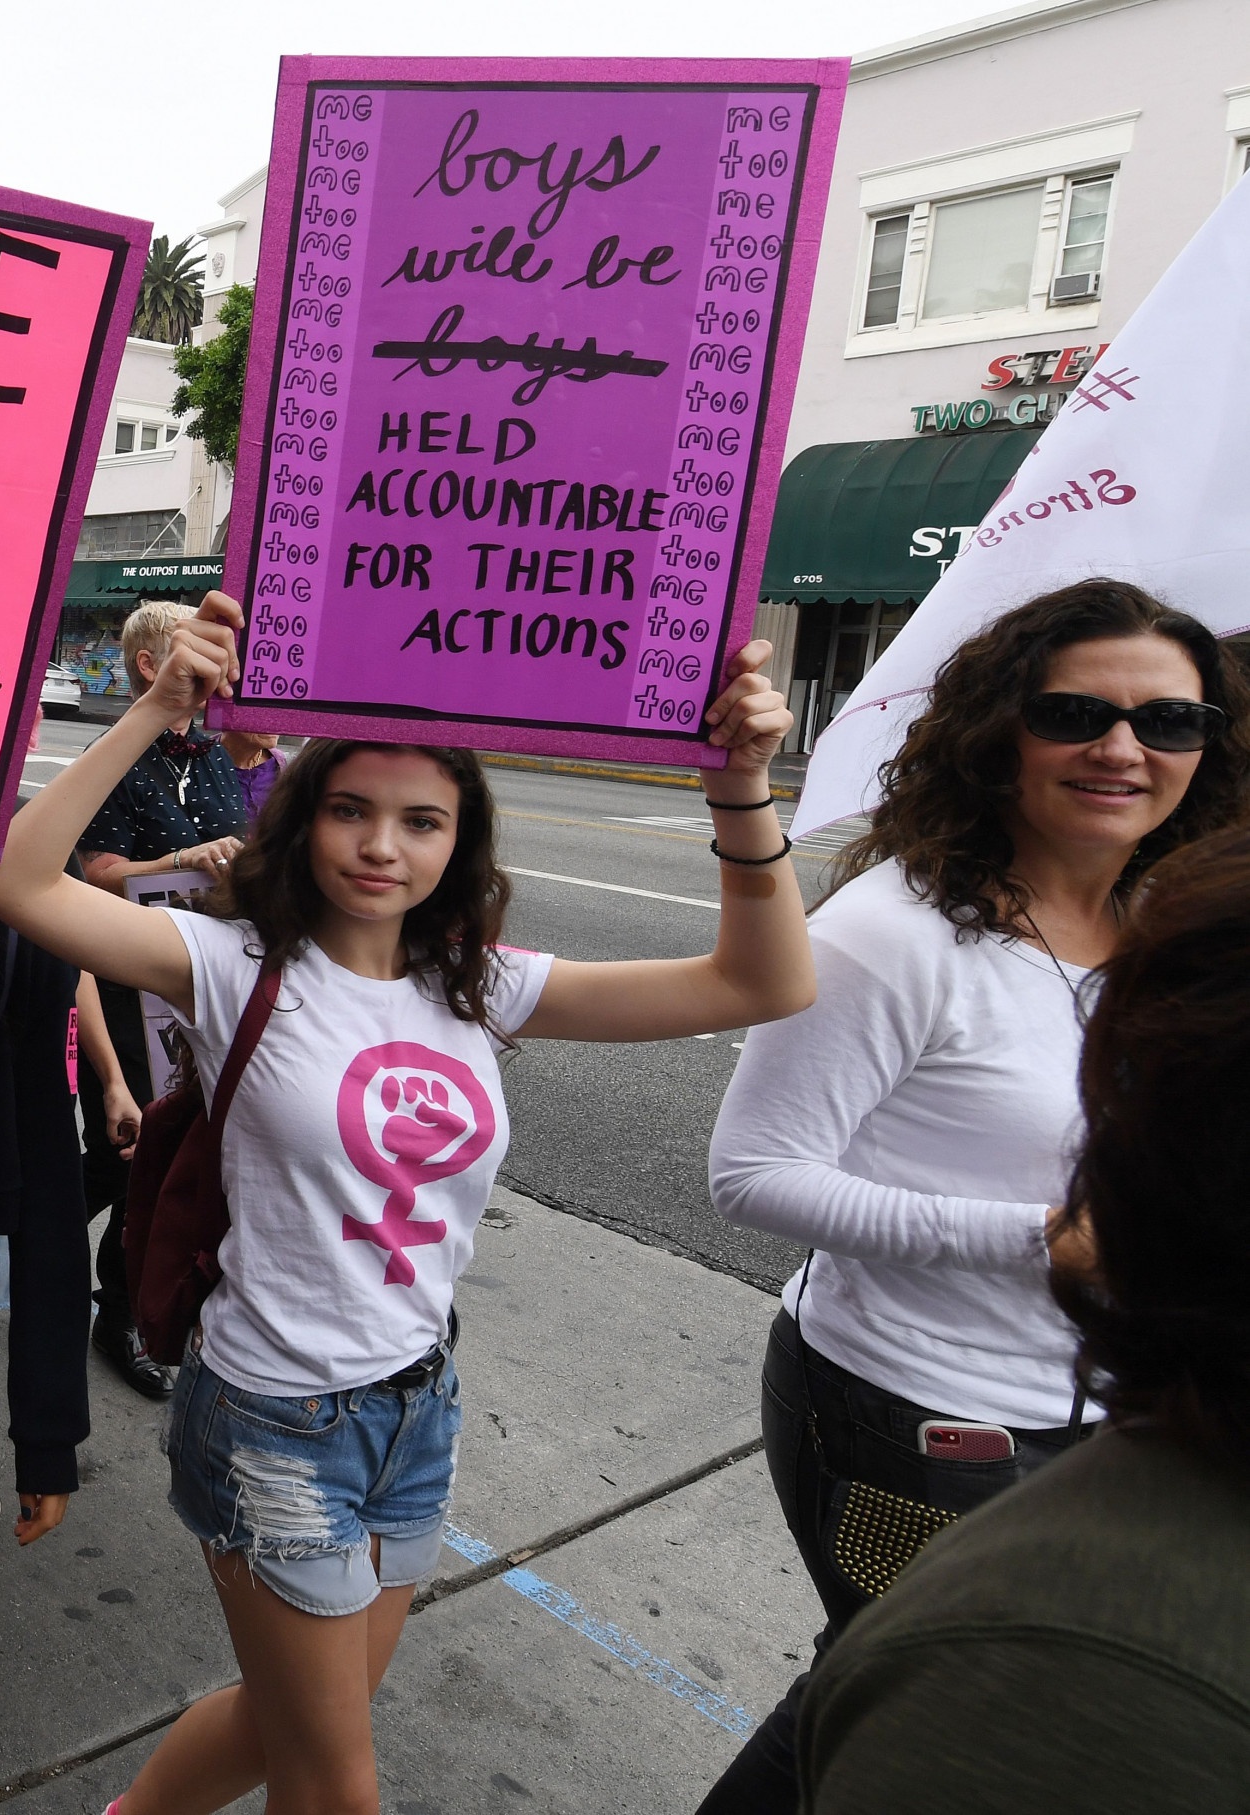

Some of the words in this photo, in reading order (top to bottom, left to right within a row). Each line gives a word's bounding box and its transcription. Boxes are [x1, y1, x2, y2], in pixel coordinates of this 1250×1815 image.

[317, 95, 373, 121] me
[727, 106, 791, 133] me
[313, 125, 369, 162] too
[719, 140, 788, 179] too
[308, 166, 361, 195] me
[413, 109, 660, 239] boys
[305, 195, 357, 227] too
[717, 189, 775, 219] me
[300, 231, 351, 260] me
[382, 226, 552, 288] will
[562, 235, 682, 290] be
[710, 224, 783, 260] too
[298, 262, 351, 297] too
[705, 266, 768, 293] me
[292, 298, 343, 328] me
[696, 301, 760, 335] too
[288, 328, 343, 363] too
[689, 343, 752, 374] me
[283, 367, 338, 396] me
[980, 343, 1111, 391] STE
[280, 397, 337, 431] too
[686, 381, 749, 415] too
[910, 398, 993, 433] TWO
[274, 433, 328, 461] me
[378, 411, 536, 465] HELD
[678, 424, 740, 456] me
[274, 464, 323, 496] too
[673, 459, 734, 496] too
[268, 502, 320, 529] me
[346, 468, 670, 532] ACCOUNTABLE
[669, 502, 729, 532] me
[265, 531, 319, 565] too
[661, 534, 720, 571] too
[122, 567, 137, 577] THE
[139, 566, 179, 576] OUTPOST
[182, 564, 223, 575] BUILDING
[343, 542, 432, 591] FOR
[468, 543, 635, 600] THEIR
[793, 574, 823, 584] 6705
[257, 573, 311, 602] me
[650, 575, 707, 606] me
[255, 604, 307, 637] too
[648, 606, 710, 642] too
[252, 639, 304, 668] me
[639, 649, 701, 682] me
[247, 666, 308, 698] too
[635, 685, 696, 725] too
